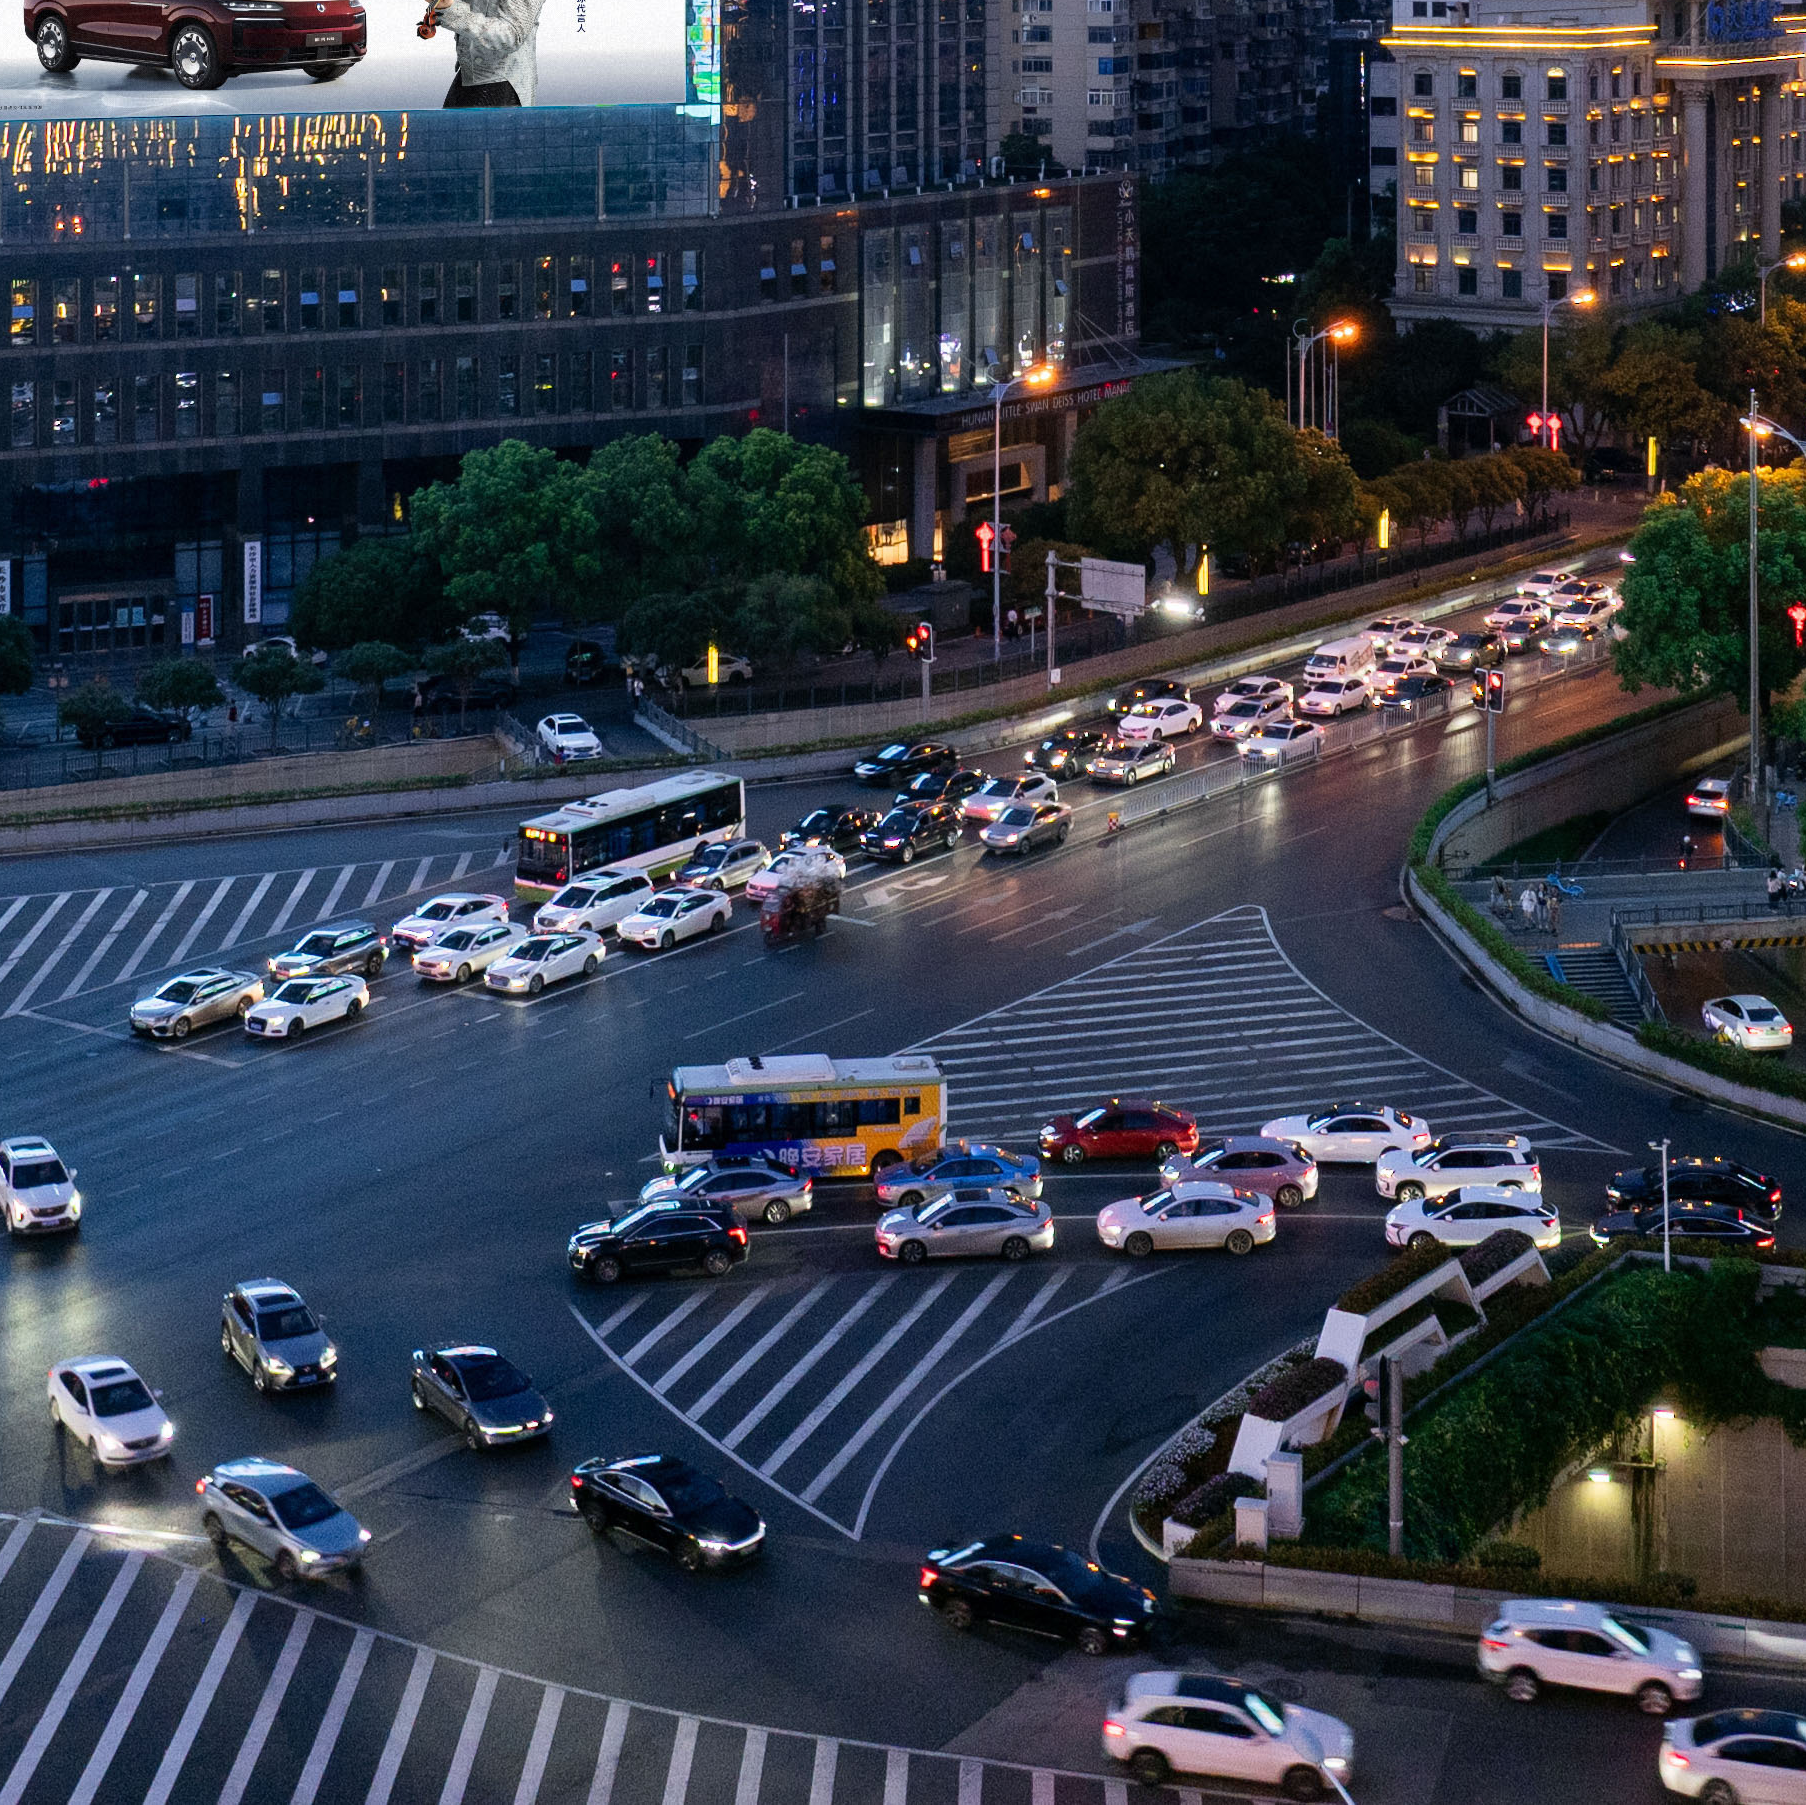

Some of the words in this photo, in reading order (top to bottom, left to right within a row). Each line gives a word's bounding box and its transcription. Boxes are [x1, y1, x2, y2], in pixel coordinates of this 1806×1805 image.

[961, 410, 994, 428] HUNAN
[1025, 398, 1049, 414] SWAN
[1052, 393, 1074, 409] DEISS
[1077, 388, 1101, 404] HOTEL
[779, 1143, 867, 1169] 晚安家居
